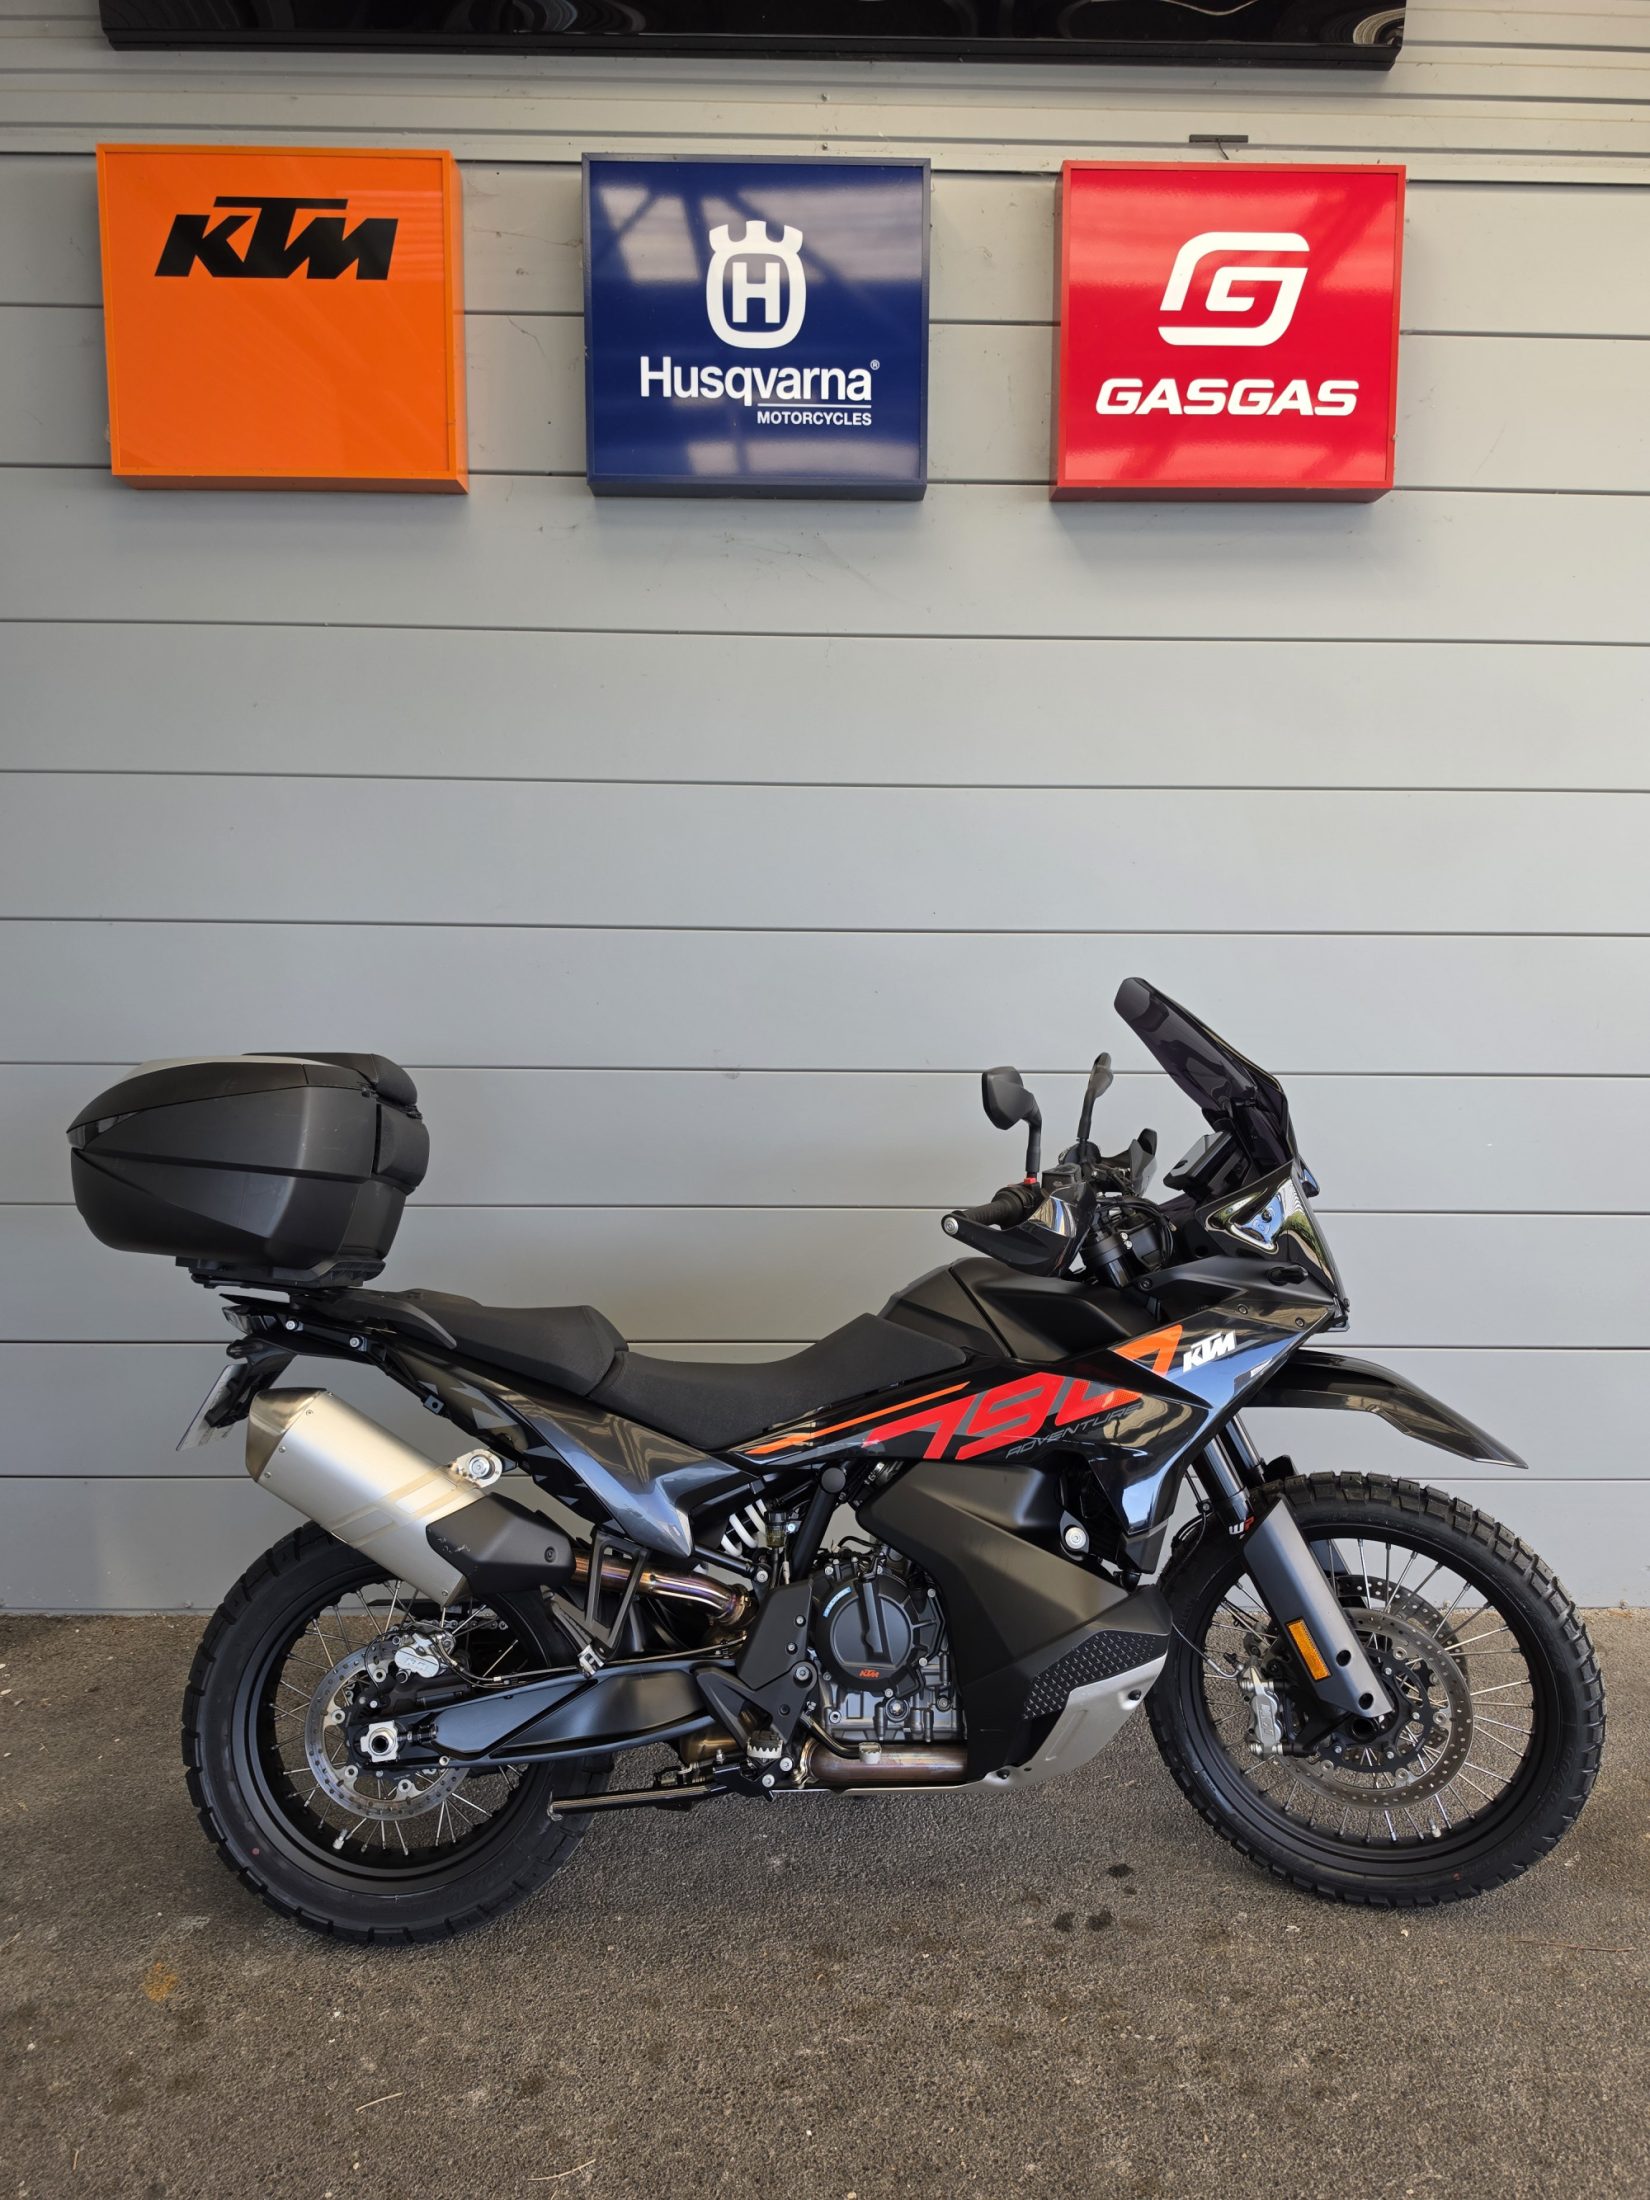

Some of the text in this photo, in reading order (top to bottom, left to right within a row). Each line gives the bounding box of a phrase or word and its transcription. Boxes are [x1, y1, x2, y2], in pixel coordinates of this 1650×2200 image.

[154, 196, 398, 281] KTM
[1095, 378, 1360, 416] GASGAS
[756, 411, 872, 426] MOTORCYCLES
[1182, 1330, 1237, 1374] KTM
[1005, 1401, 1145, 1460] ADVENTURE
[859, 1668, 880, 1679] KTM
